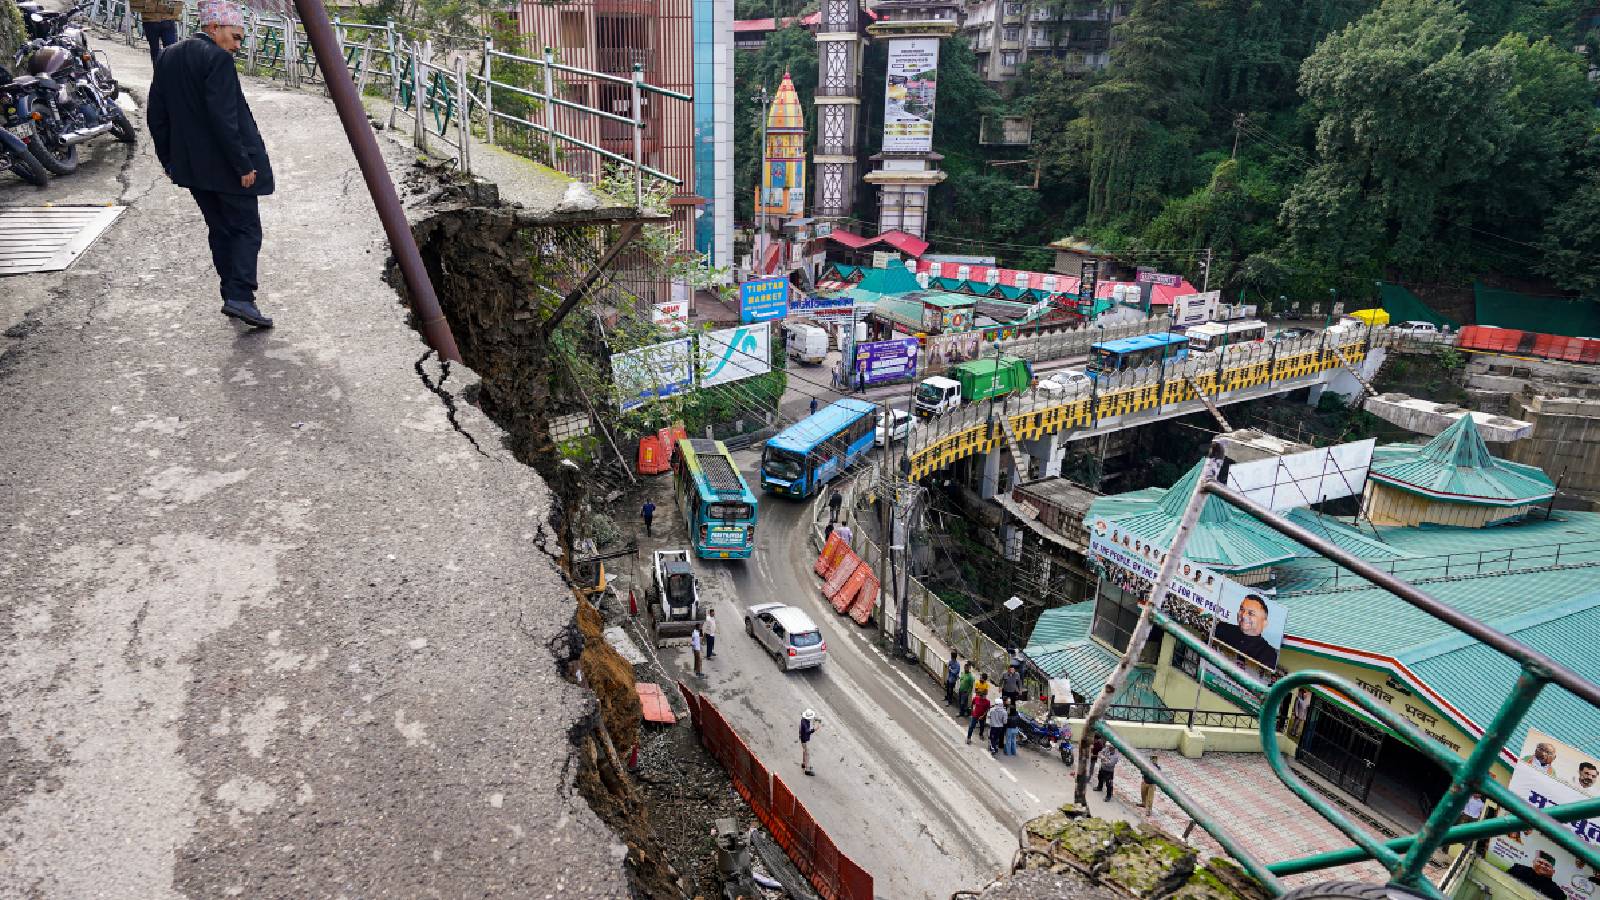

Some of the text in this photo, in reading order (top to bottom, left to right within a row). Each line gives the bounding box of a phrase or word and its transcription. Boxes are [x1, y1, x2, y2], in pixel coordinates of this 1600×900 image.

[747, 282, 783, 293] TIBETAN
[748, 293, 782, 304] MARKET
[1132, 562, 1141, 571] BY
[1178, 585, 1191, 598] FOR
[1192, 592, 1204, 605] THE
[1356, 678, 1394, 704] राजीव
[1405, 703, 1439, 728] भवन
